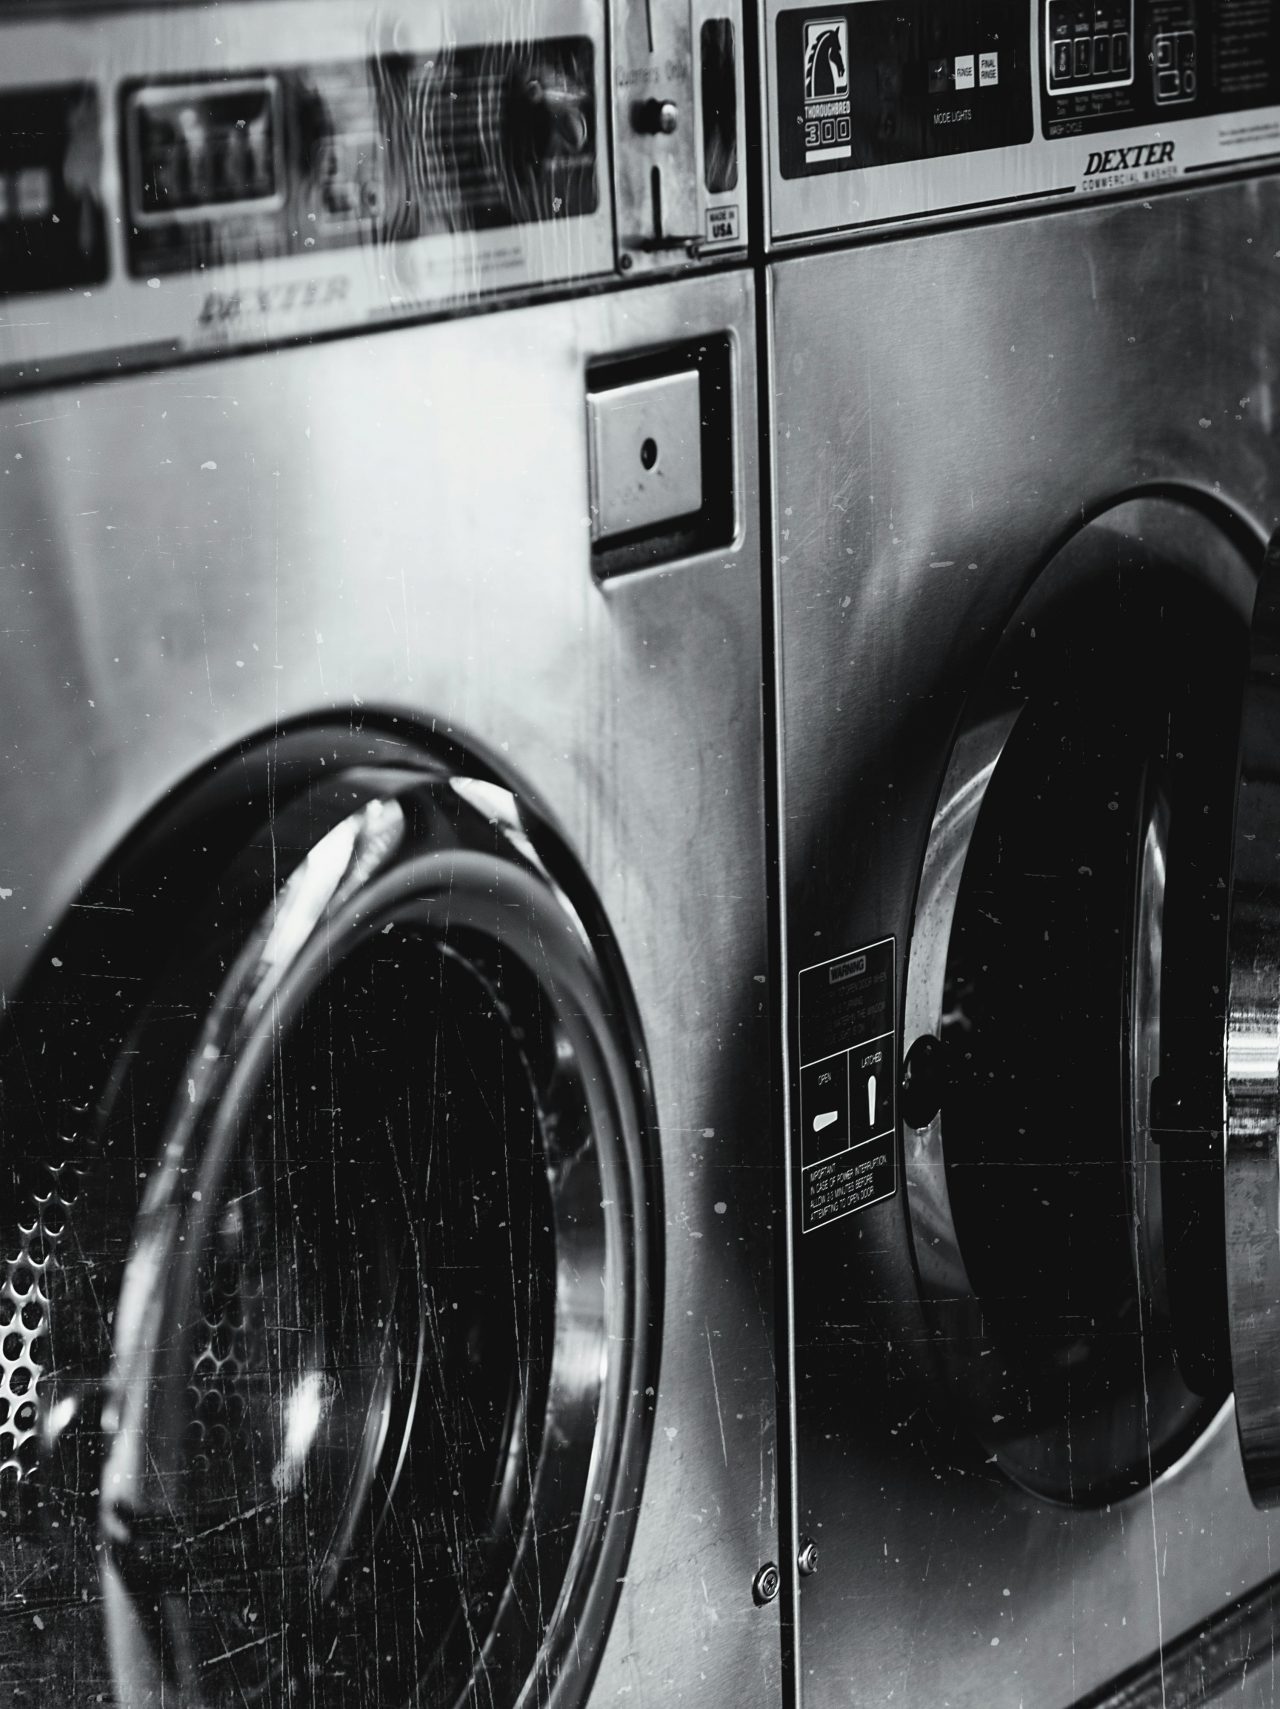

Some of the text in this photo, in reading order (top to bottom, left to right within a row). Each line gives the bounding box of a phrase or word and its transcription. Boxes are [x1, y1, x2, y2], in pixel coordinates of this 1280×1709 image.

[805, 100, 850, 119] THOROUGHBRED
[933, 109, 972, 124] MODE LIGHTS
[805, 116, 851, 147] 300
[1083, 140, 1175, 176] DEXTER
[1082, 166, 1178, 191] COMMERCIAL WASHER
[710, 210, 735, 222] MADE IN
[712, 222, 733, 239] USA
[861, 1051, 882, 1068] LATCHED
[818, 1072, 831, 1086] OPEN
[810, 1162, 836, 1182] IMPORTANT
[816, 1179, 829, 1193] CASE
[829, 1175, 836, 1187] OF
[837, 1168, 854, 1183] POWER
[855, 1172, 874, 1190] BEFORE
[847, 1192, 860, 1206] OPEN
[860, 1185, 875, 1200] DOOR
